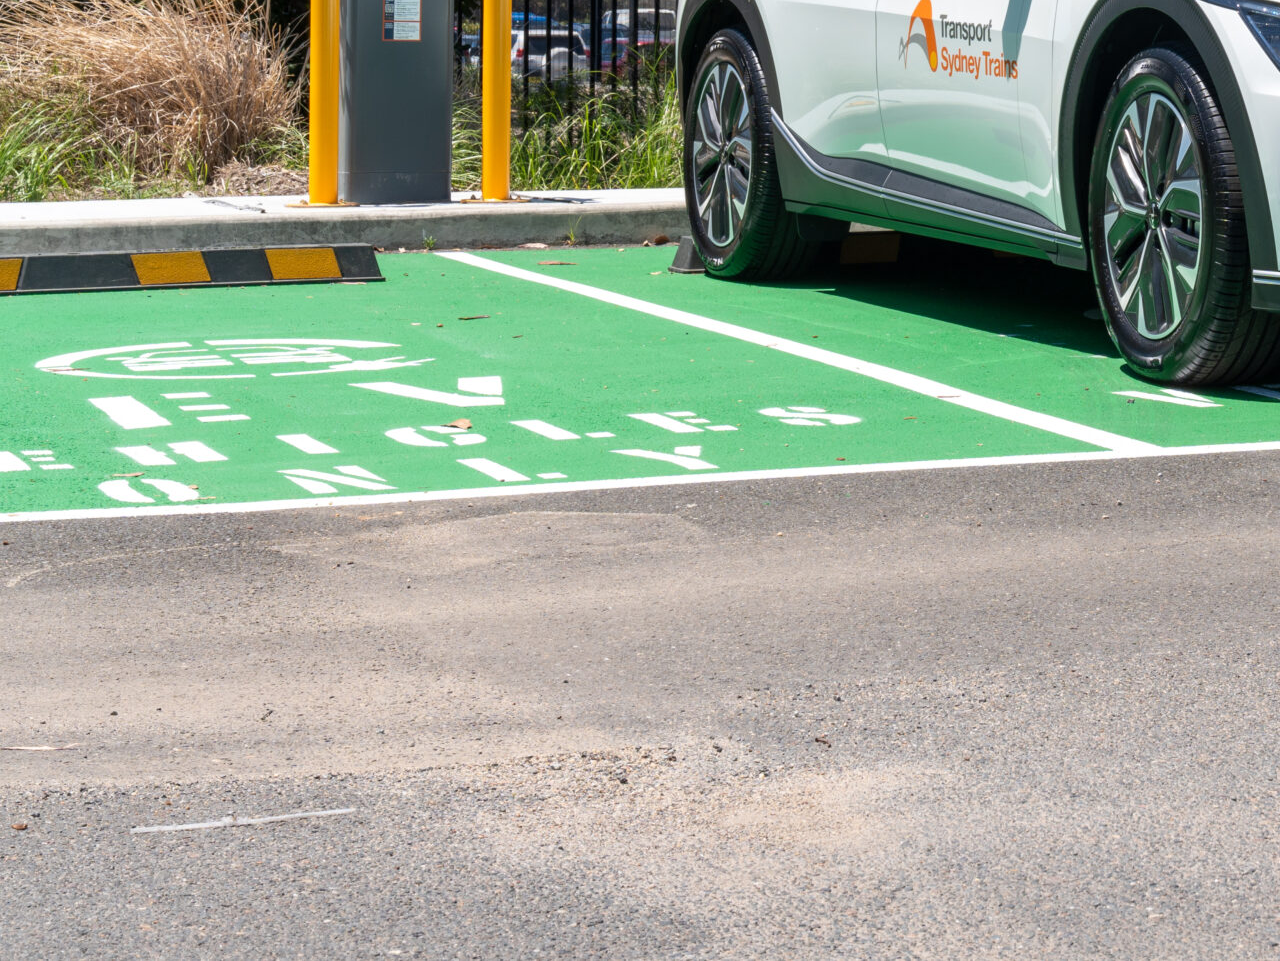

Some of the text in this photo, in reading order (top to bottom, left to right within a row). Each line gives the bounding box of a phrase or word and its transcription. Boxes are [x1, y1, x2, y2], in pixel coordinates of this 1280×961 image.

[940, 14, 992, 46] Transport
[941, 46, 1018, 80] Sydney Trains
[88, 375, 506, 430] EV
[0, 405, 863, 473] EHICLES
[97, 445, 720, 504] ONLY
